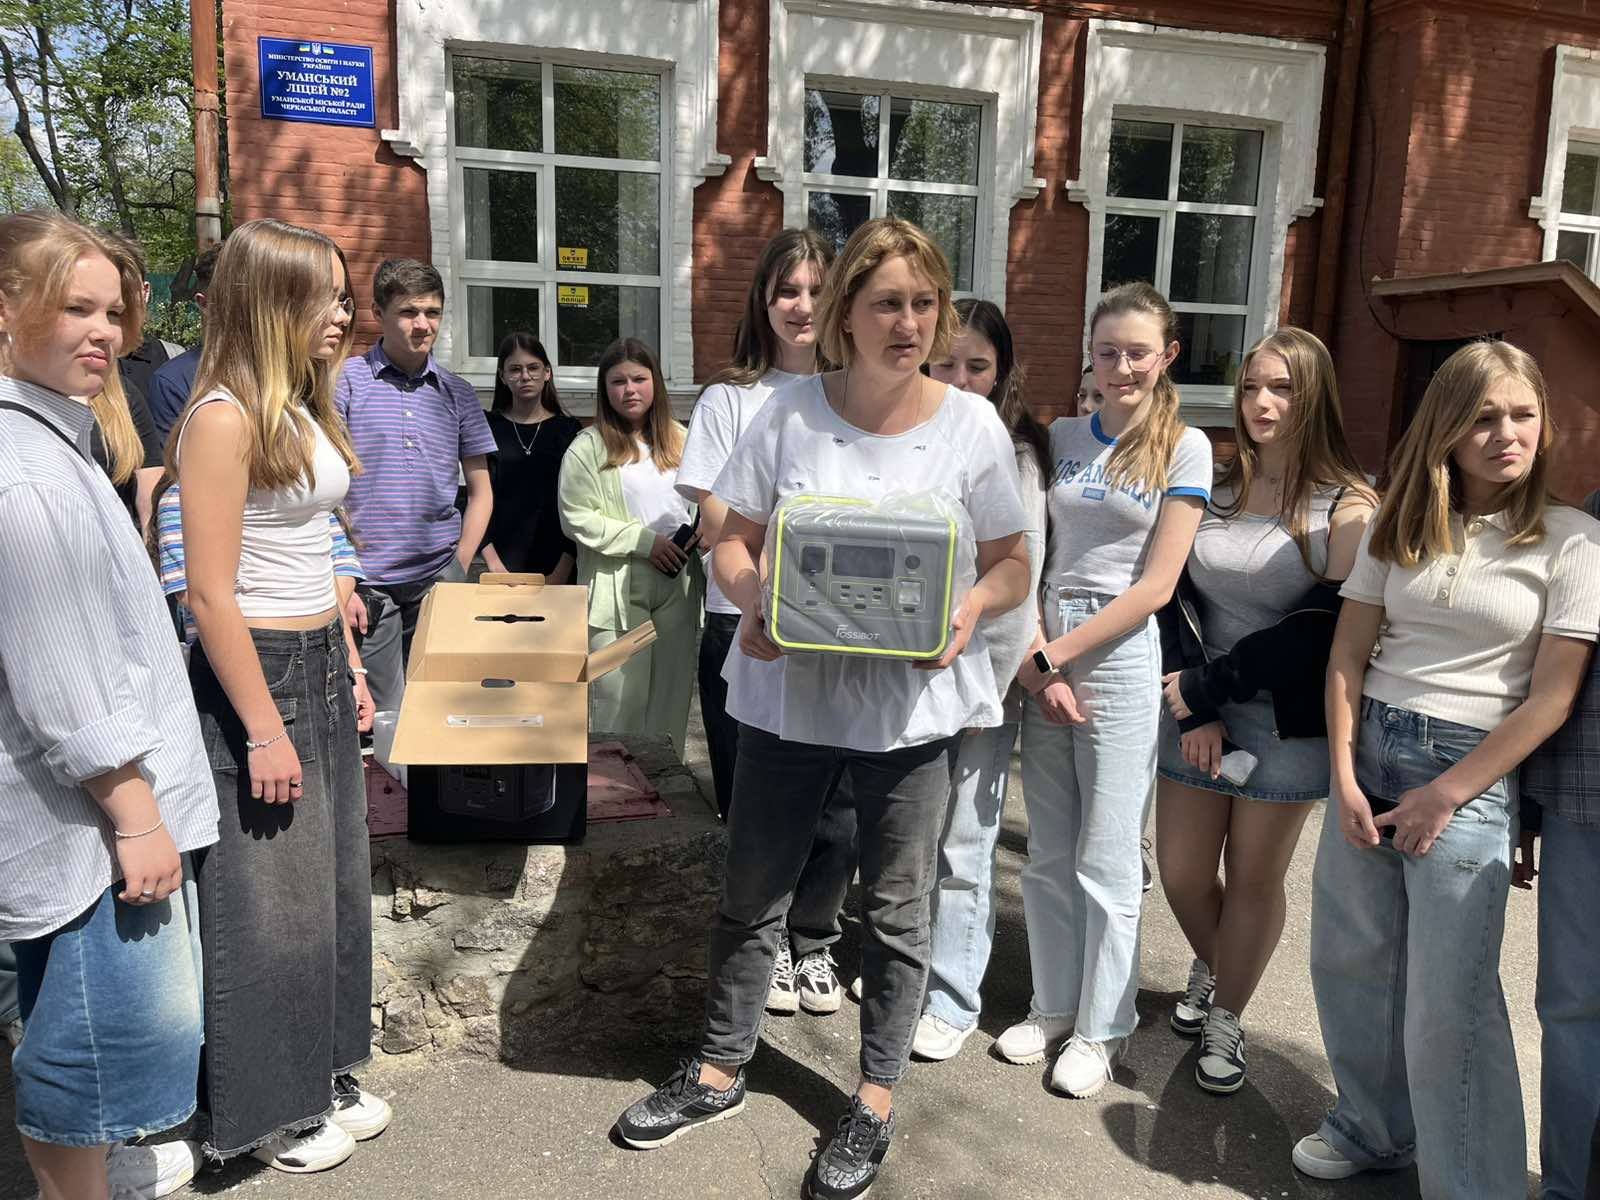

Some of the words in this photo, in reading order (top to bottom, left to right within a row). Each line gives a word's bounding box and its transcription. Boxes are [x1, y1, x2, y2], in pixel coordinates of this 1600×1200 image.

[268, 53, 314, 63] МІНІСТЕРСТВО
[315, 57, 338, 65] ОСВІТИ
[343, 60, 365, 68] НАУКИ
[277, 70, 358, 87] УМАНСЬКИЙ
[286, 83, 328, 95] ЛІЦЕЙ
[330, 87, 350, 97] №2
[271, 95, 314, 105] УМАНСЬКОЇ
[315, 99, 345, 107] МІСЬКОЇ
[281, 103, 325, 113] ЧЕРКАСЬКОЇ
[326, 107, 357, 116] ОБЛАСТІ
[835, 624, 881, 641] FOSSIBOT
